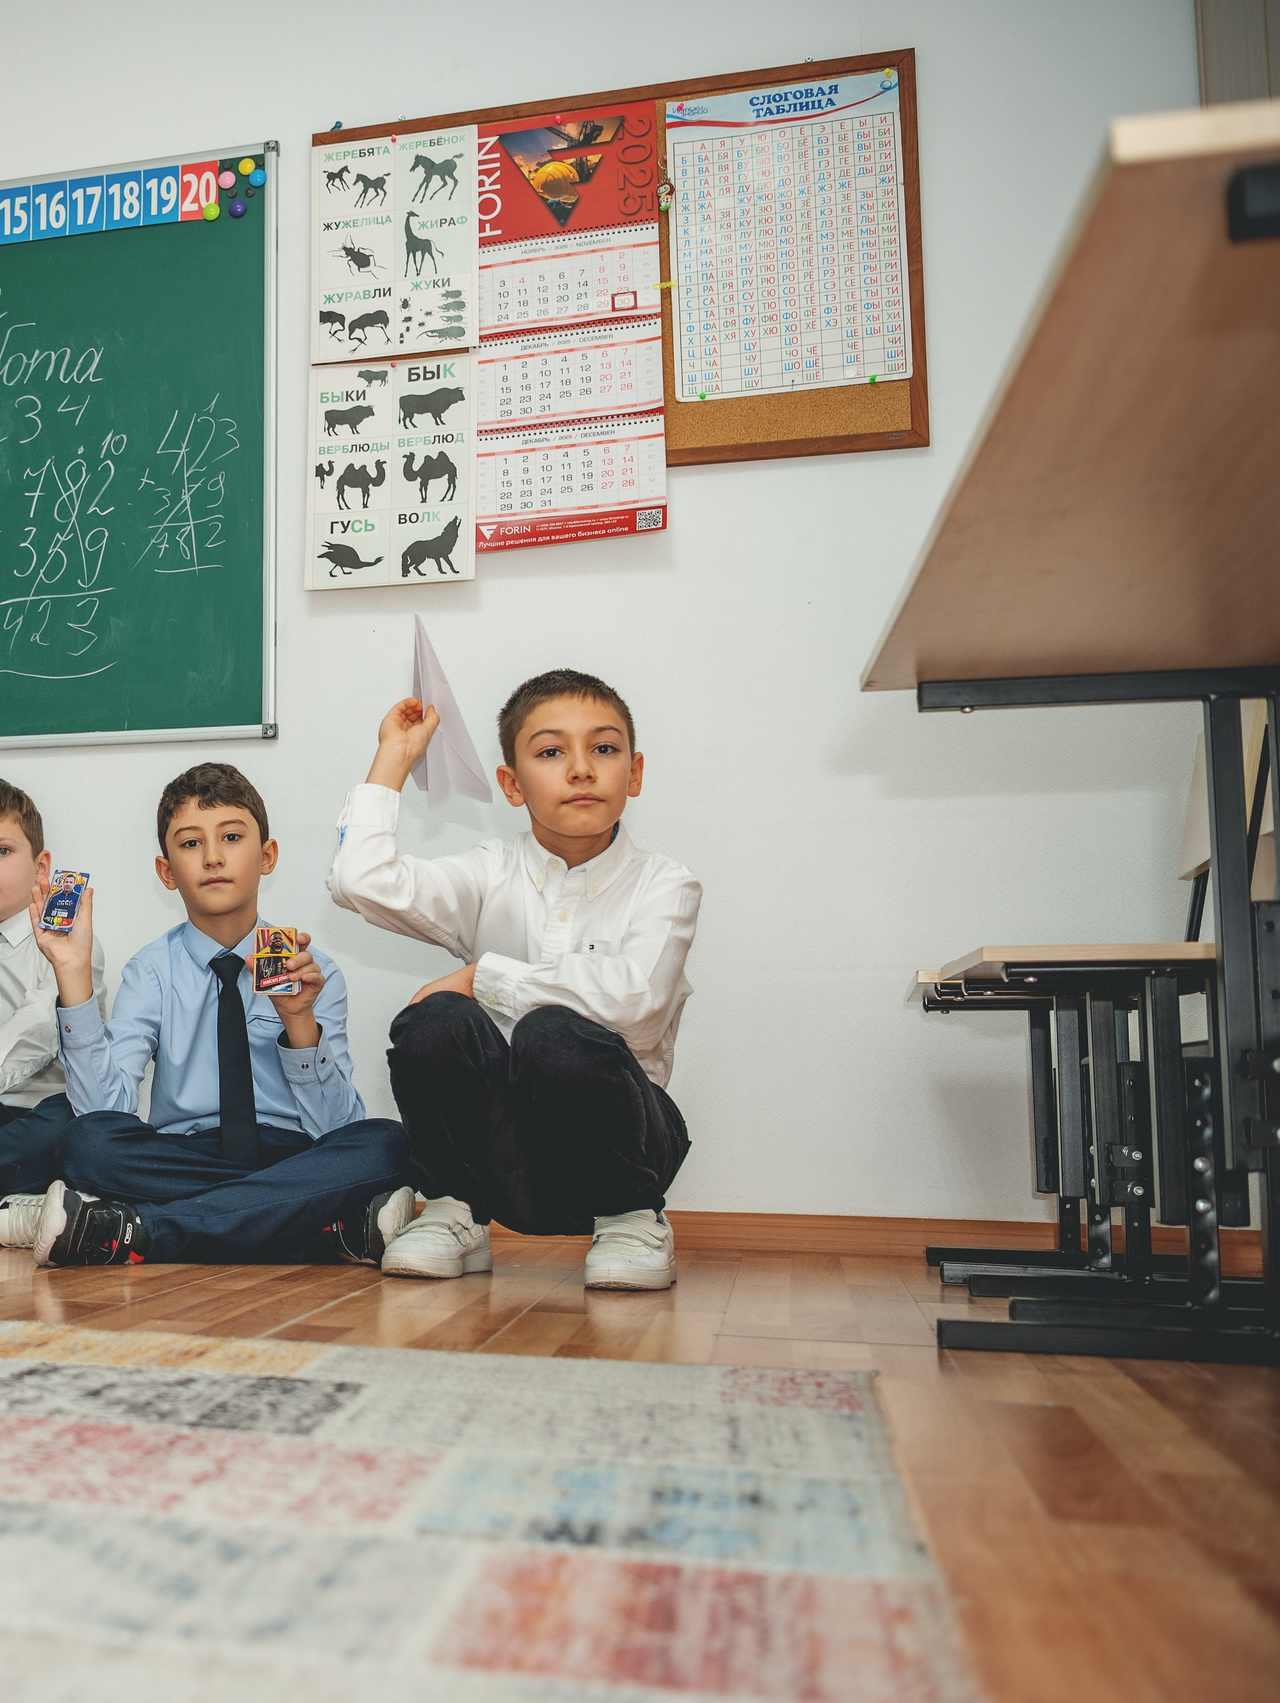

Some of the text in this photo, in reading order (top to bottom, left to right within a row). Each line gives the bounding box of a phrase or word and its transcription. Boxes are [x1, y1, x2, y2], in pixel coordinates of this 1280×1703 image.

[749, 84, 839, 107] СЛОГОВАЯ
[753, 97, 837, 118] ТАБЛИЦА
[398, 134, 466, 151] ЖЕРЕБЁНОК
[718, 152, 728, 160] БЯ
[737, 149, 748, 158] БУ
[756, 145, 769, 154] БЮ
[777, 142, 789, 150] БО
[798, 138, 808, 147] БЁ
[818, 136, 828, 144] БЭ
[838, 133, 848, 141] БЕ
[857, 131, 870, 139] БЫ
[878, 128, 890, 136] БИ
[323, 145, 390, 163] ЖЕРЕБЯТА
[617, 114, 655, 216] 2025
[478, 135, 502, 237] FORIN
[34, 191, 67, 231] 16
[71, 186, 103, 226] 17
[108, 181, 141, 221] 18
[145, 175, 178, 216] 19
[181, 171, 218, 212] 20
[323, 215, 392, 231] ЖУЖЕЛИЦА
[417, 215, 468, 231] ЖИРАФ
[521, 247, 547, 255] НОЯБРЬ
[575, 238, 612, 248] NOVEMBER
[410, 277, 451, 292] ЖУКИ
[323, 287, 392, 305] ЖУРАВЛИ
[704, 310, 715, 318] ТА
[724, 307, 734, 315] ТЯ
[743, 304, 754, 312] ТУ
[762, 301, 776, 310] ТЮ
[783, 299, 796, 307] ТО
[805, 295, 815, 304] ТЁ
[824, 294, 836, 302] ТЭ
[845, 291, 856, 299] ТЕ
[864, 289, 878, 297] ТЫ
[886, 287, 898, 295] ТИ
[520, 342, 549, 351] ДЕКАБРЬ
[578, 333, 614, 343] DECEMBER
[407, 363, 456, 382] БЫК
[320, 389, 367, 404] БЫКИ
[397, 433, 465, 448] ВЕРБЛЮД
[521, 437, 551, 446] ДЕКАБРЬ
[580, 429, 616, 439] DECEMBER
[318, 441, 390, 456] ВЕРБЛЮДЫ
[622, 479, 634, 487] 28
[397, 511, 441, 525] ВОЛК
[329, 520, 376, 535] ГУСЬ
[499, 525, 531, 535] FORIN
[478, 540, 505, 549] Лучшие
[506, 537, 537, 547] решения
[551, 532, 576, 541] вашего
[577, 528, 606, 538] бизнеса
[607, 525, 629, 534] online
